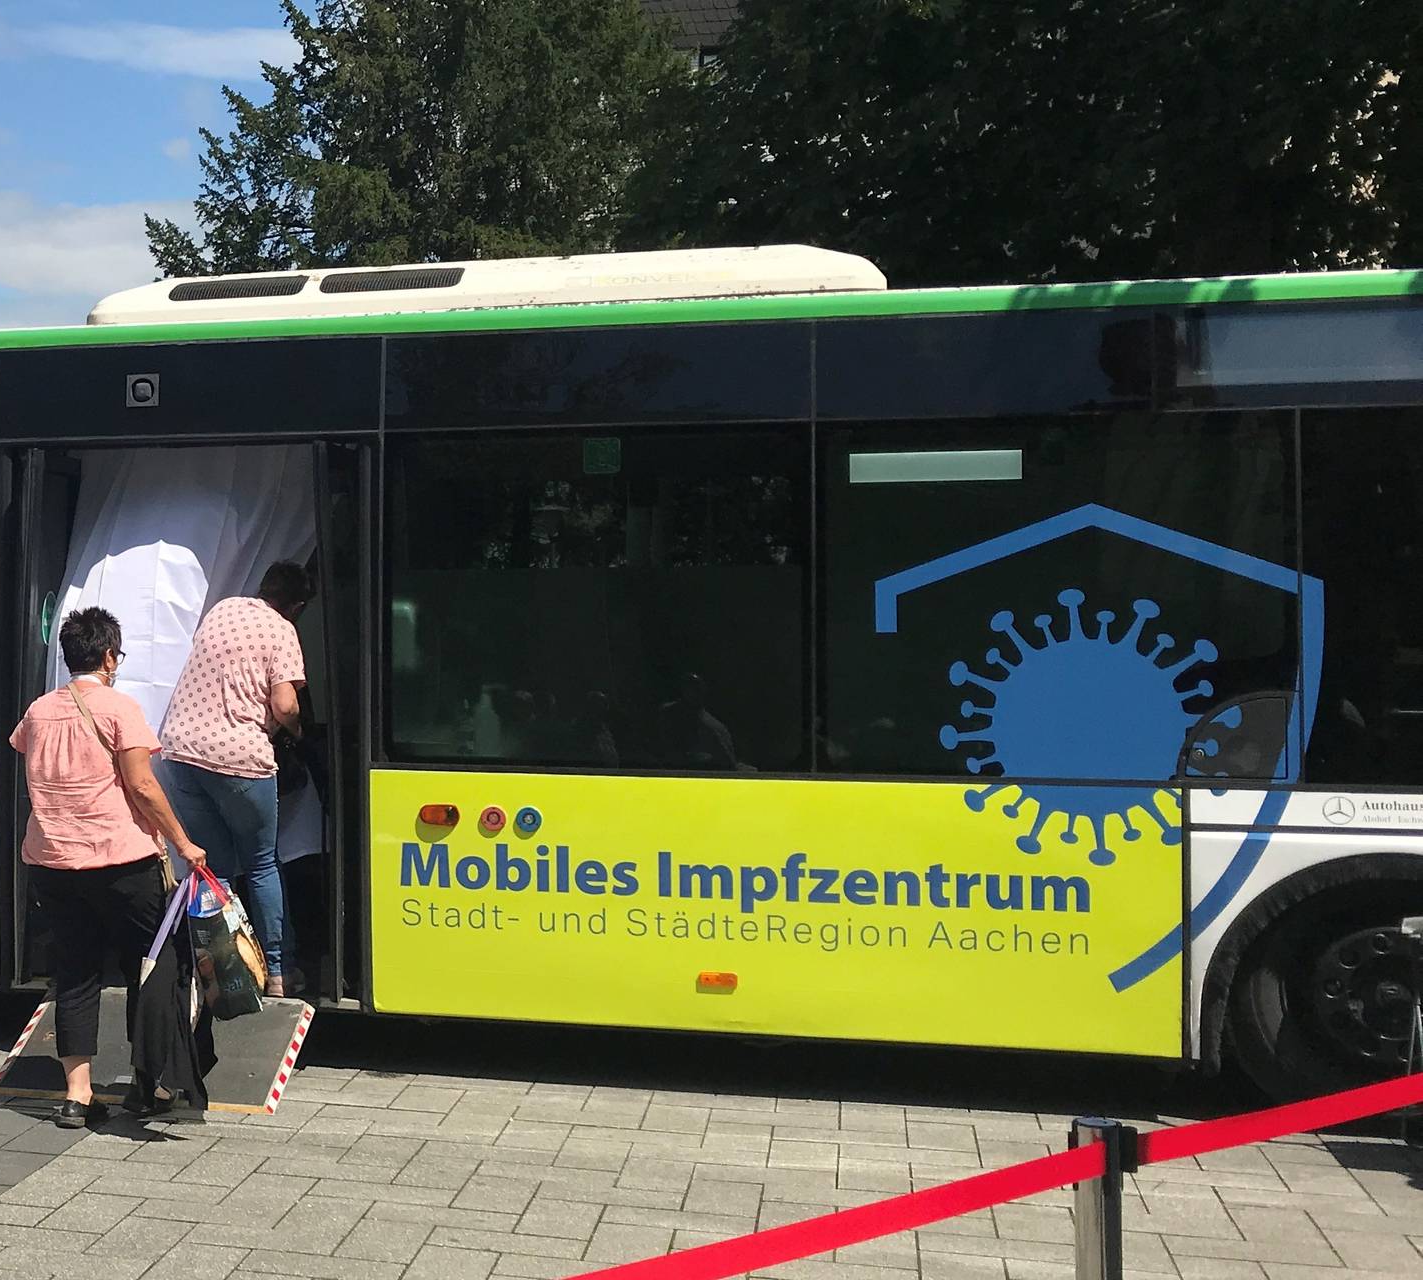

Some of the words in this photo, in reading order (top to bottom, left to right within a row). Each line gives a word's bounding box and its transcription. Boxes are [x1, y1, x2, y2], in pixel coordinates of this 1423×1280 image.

[399, 841, 640, 897] Mobiles
[657, 850, 1091, 915] Impfzentrum
[401, 898, 520, 931] Stadt-
[538, 907, 608, 935] und
[626, 908, 908, 952] StädteRegion
[927, 920, 1090, 956] Aachen
